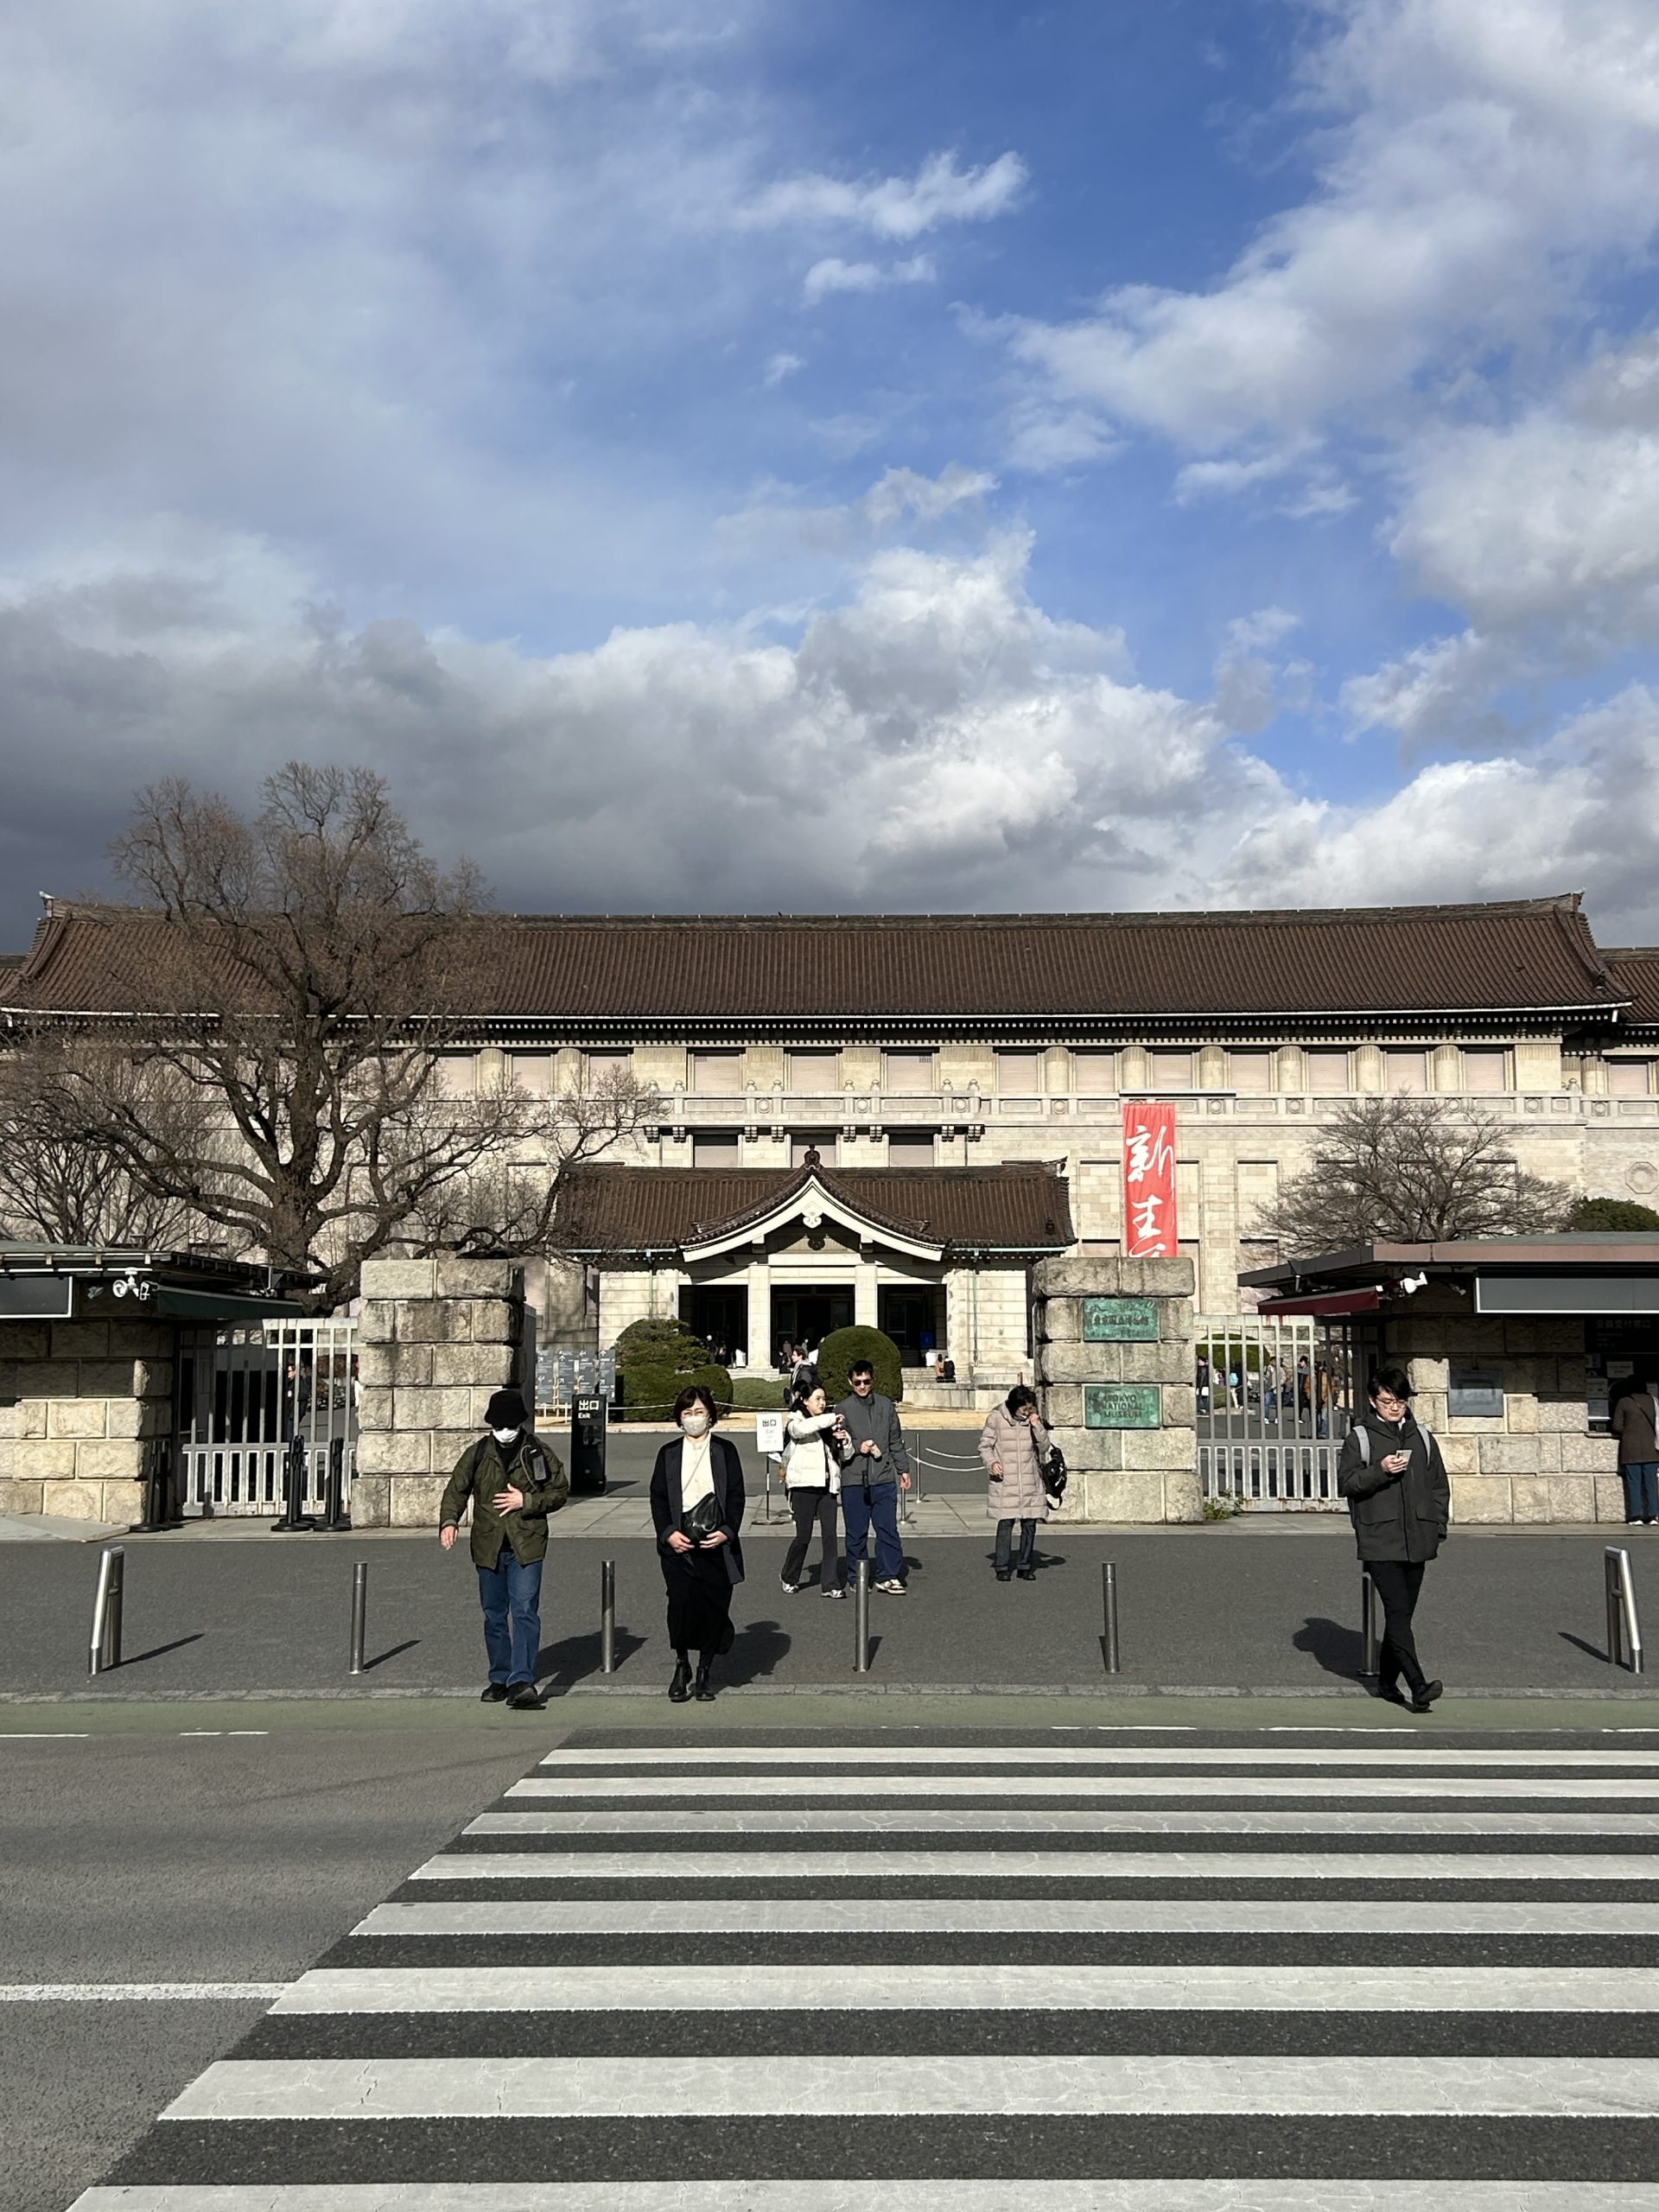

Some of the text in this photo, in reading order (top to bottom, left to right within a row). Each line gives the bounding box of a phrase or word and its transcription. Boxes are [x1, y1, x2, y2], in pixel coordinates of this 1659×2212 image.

[1107, 1394, 1136, 1403] TOKYO
[579, 1400, 600, 1411] 出口
[1103, 1402, 1144, 1411] NATIONAL
[1103, 1410, 1142, 1419] MUSEUM
[762, 1419, 777, 1427] 出口
